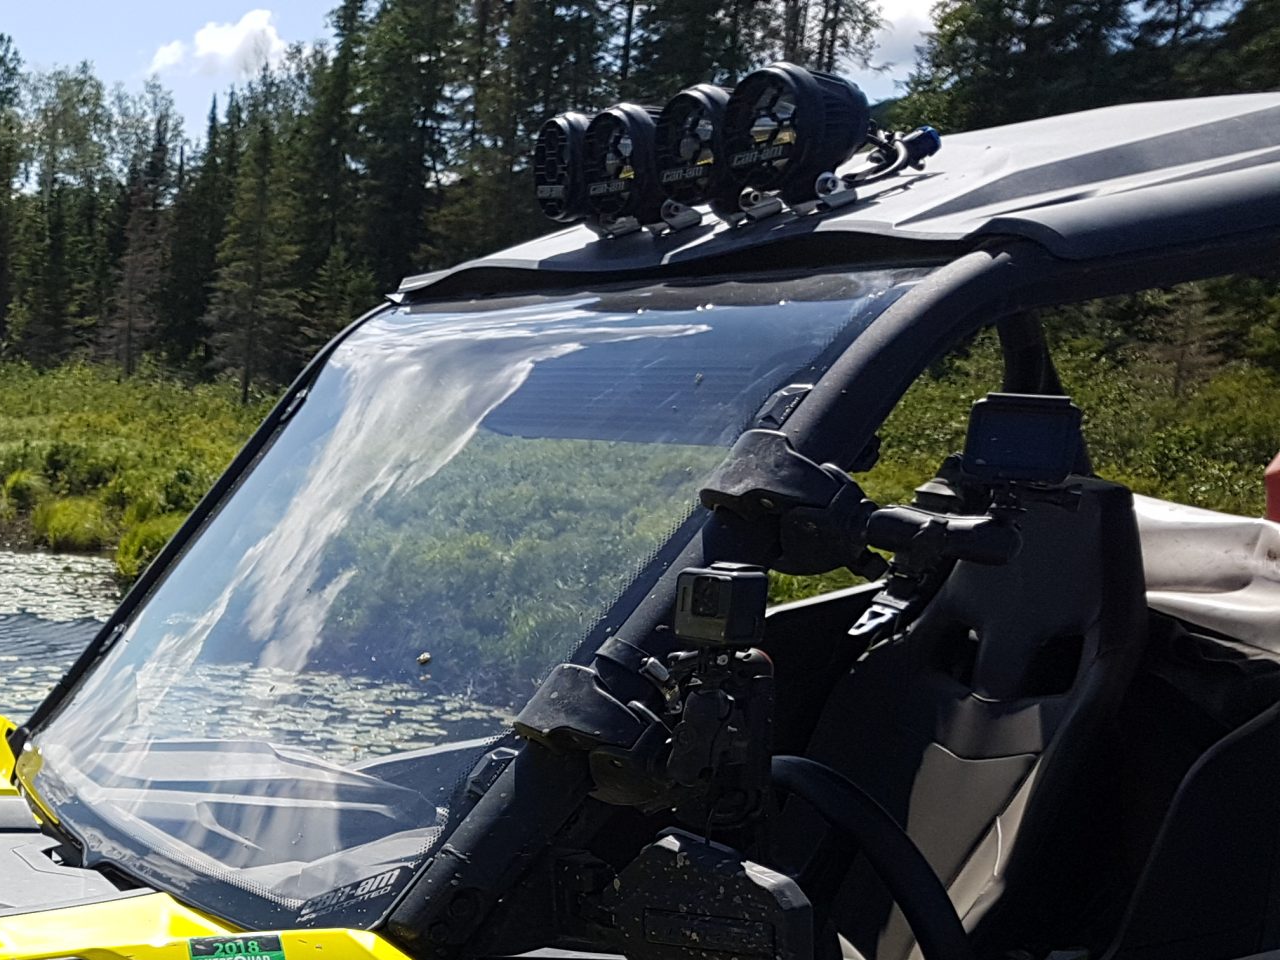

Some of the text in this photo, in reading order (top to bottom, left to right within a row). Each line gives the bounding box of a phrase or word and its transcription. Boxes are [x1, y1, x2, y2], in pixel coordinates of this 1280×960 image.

[732, 145, 784, 167] can-am
[662, 166, 704, 183] can-am
[299, 868, 401, 916] can-am
[212, 939, 261, 957] 2018
